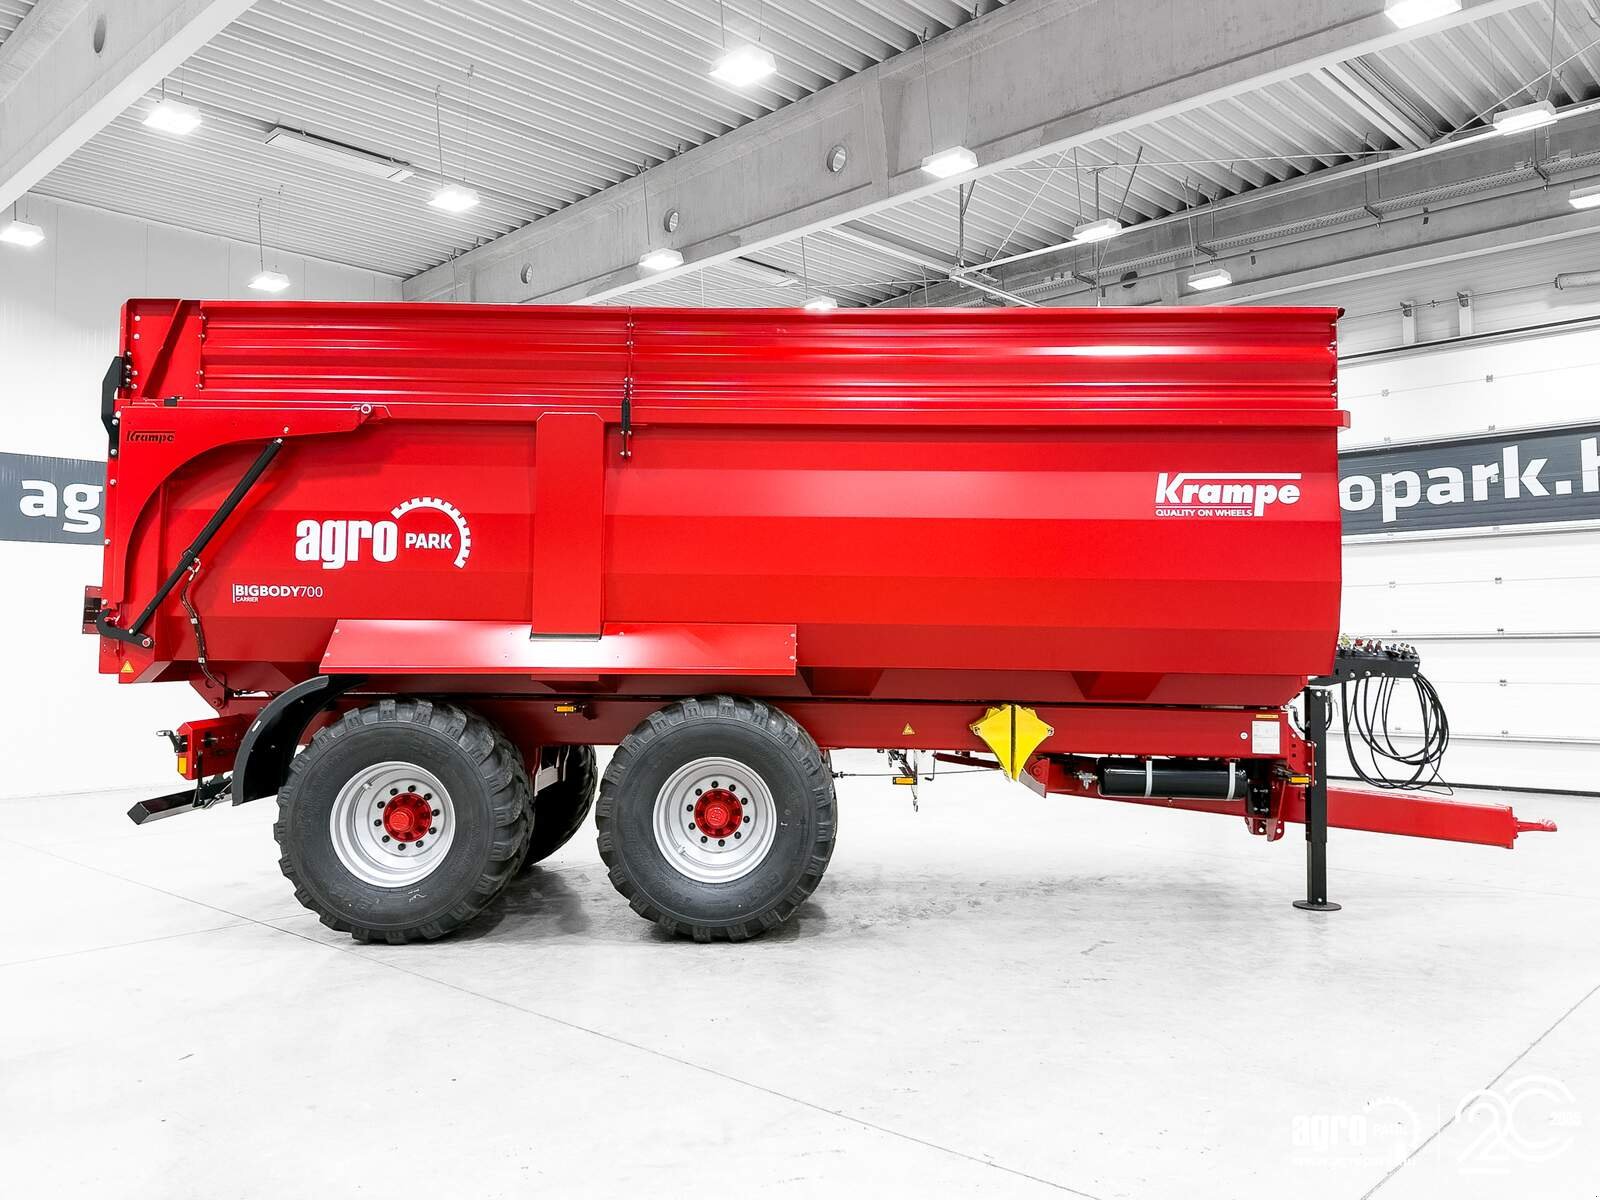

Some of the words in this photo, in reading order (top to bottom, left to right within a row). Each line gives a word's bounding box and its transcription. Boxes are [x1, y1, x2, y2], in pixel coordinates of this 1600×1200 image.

[126, 430, 176, 444] Krampe
[1155, 472, 1302, 517] Krampe
[1155, 509, 1196, 517] QUALITY
[1198, 509, 1213, 517] ON
[1215, 509, 1253, 517] WHEELS
[295, 519, 398, 570] agro
[405, 532, 453, 549] PARK
